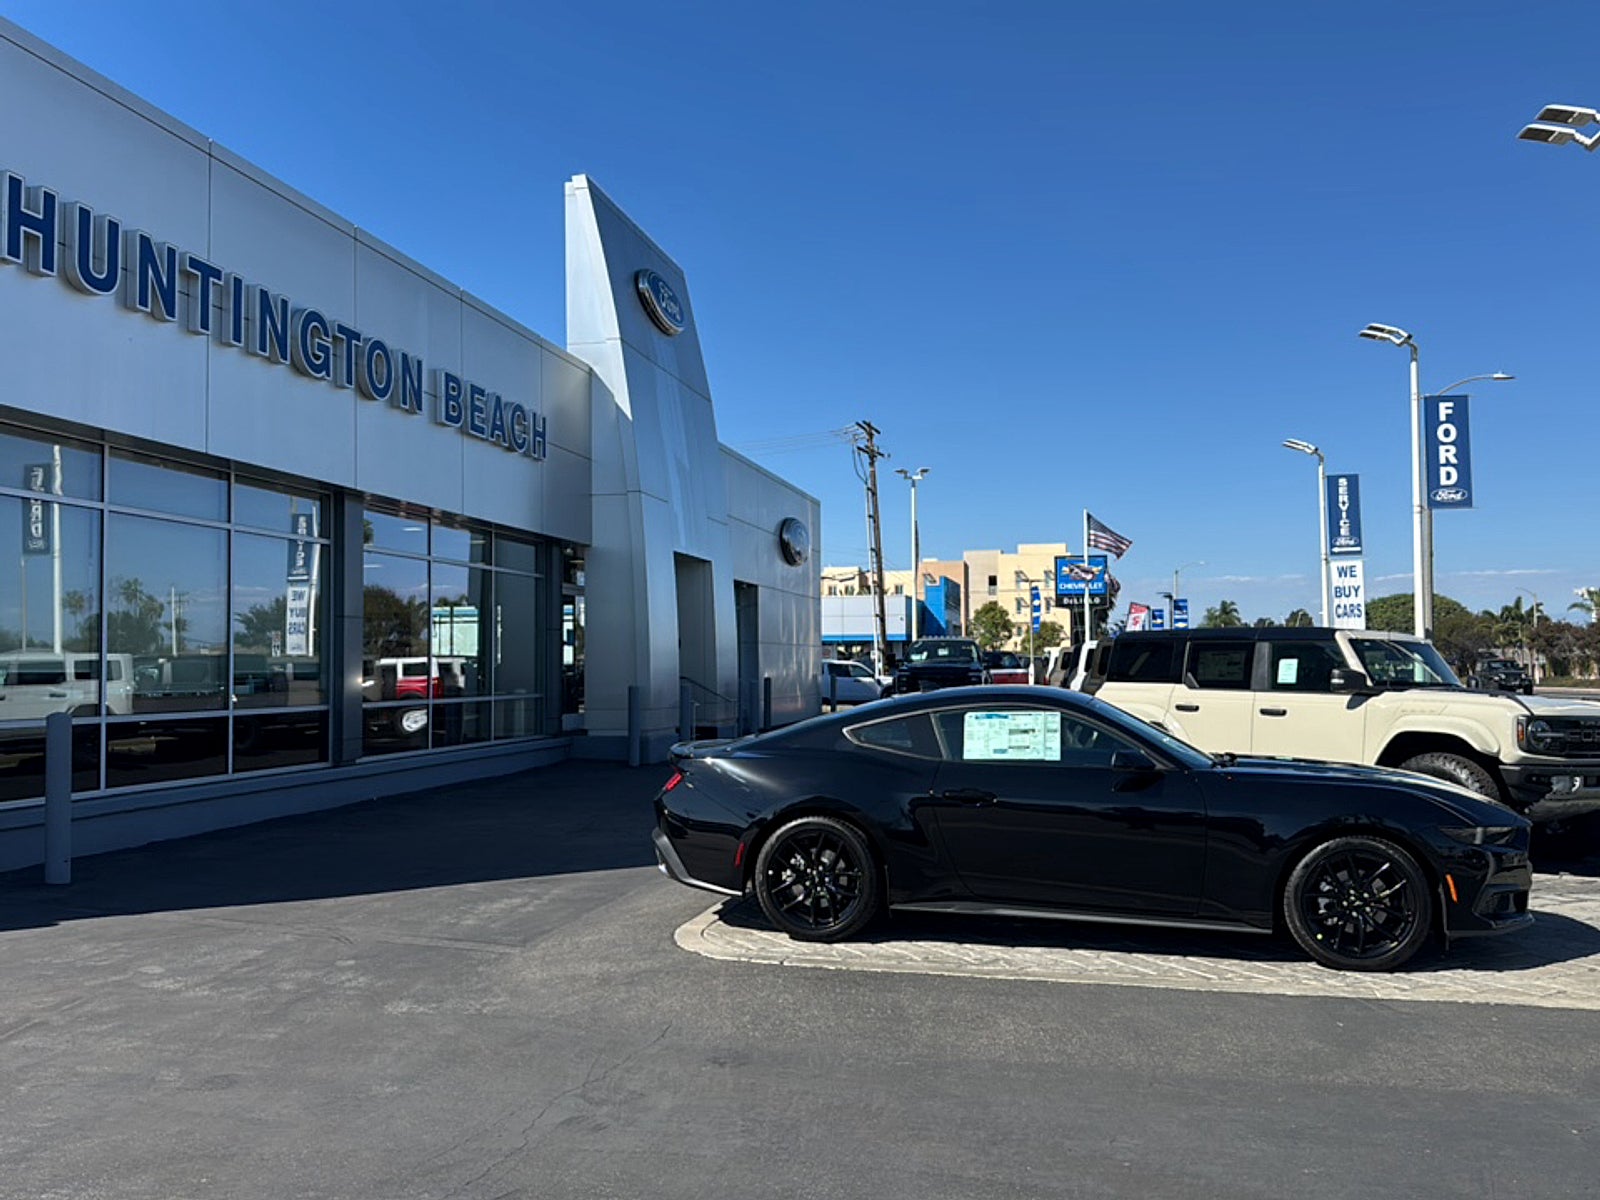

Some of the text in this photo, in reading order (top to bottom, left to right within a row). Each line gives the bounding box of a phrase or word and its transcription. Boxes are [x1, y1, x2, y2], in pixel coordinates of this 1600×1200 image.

[3, 171, 547, 460] HUNTINGTON BEACH
[1437, 402, 1458, 486] FORD
[1338, 477, 1350, 536] SERVICE
[1337, 565, 1358, 578] WE
[1059, 582, 1103, 590] CHEVRLET
[1334, 585, 1361, 598] BUY
[1335, 603, 1363, 619] CARS
